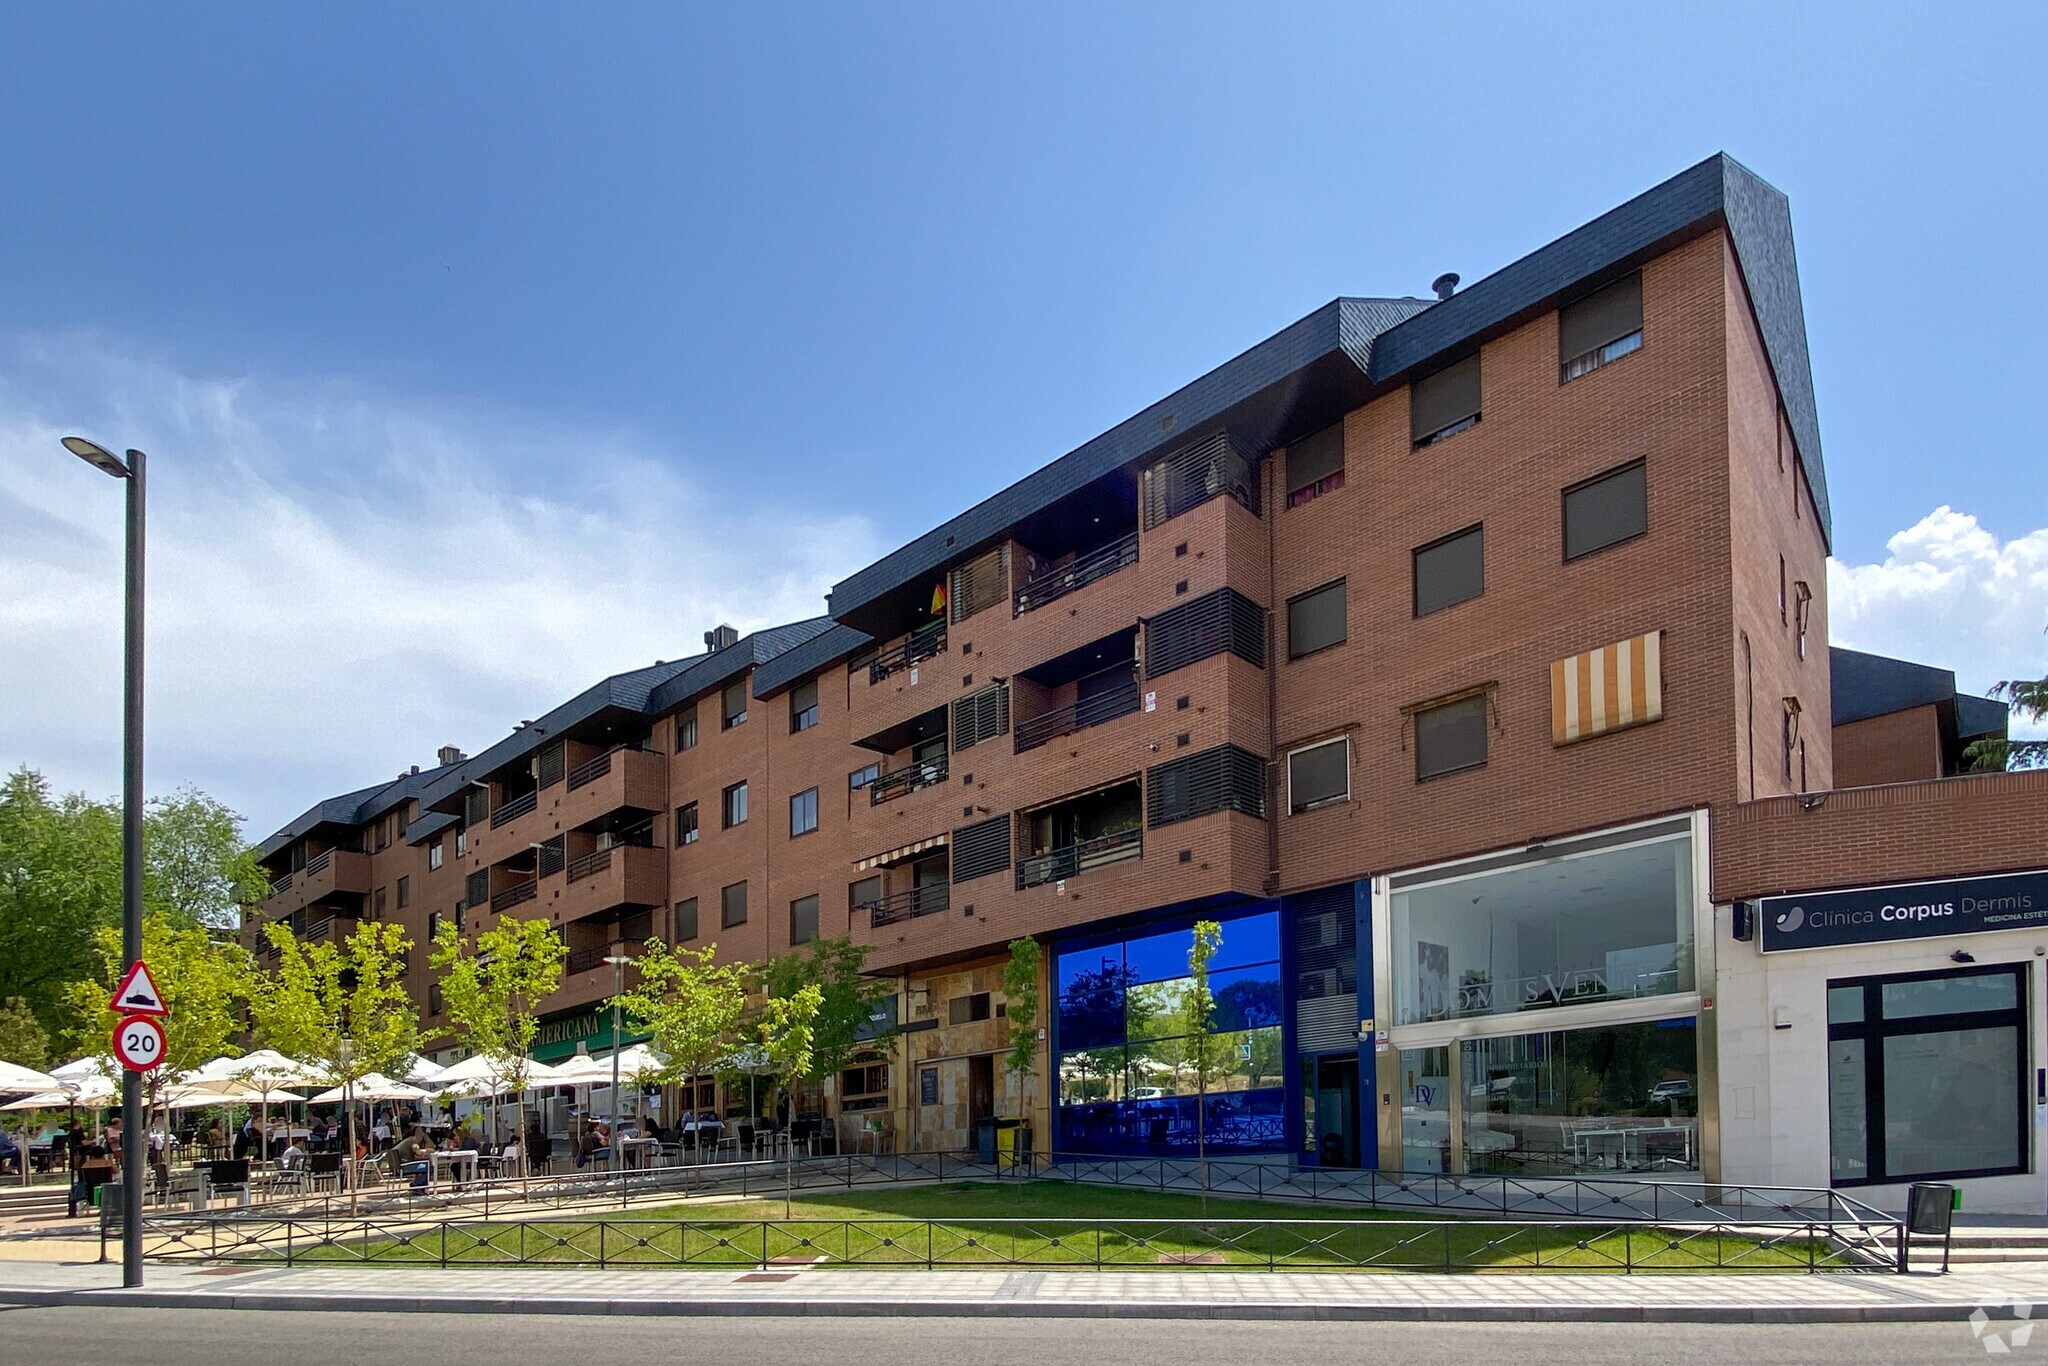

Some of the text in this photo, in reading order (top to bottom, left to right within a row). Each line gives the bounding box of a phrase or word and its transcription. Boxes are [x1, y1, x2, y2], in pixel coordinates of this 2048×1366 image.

[1809, 892, 2032, 928] Clínica Corpus Dermis
[1984, 913, 2022, 923] MEDICINA
[127, 1033, 155, 1052] 20
